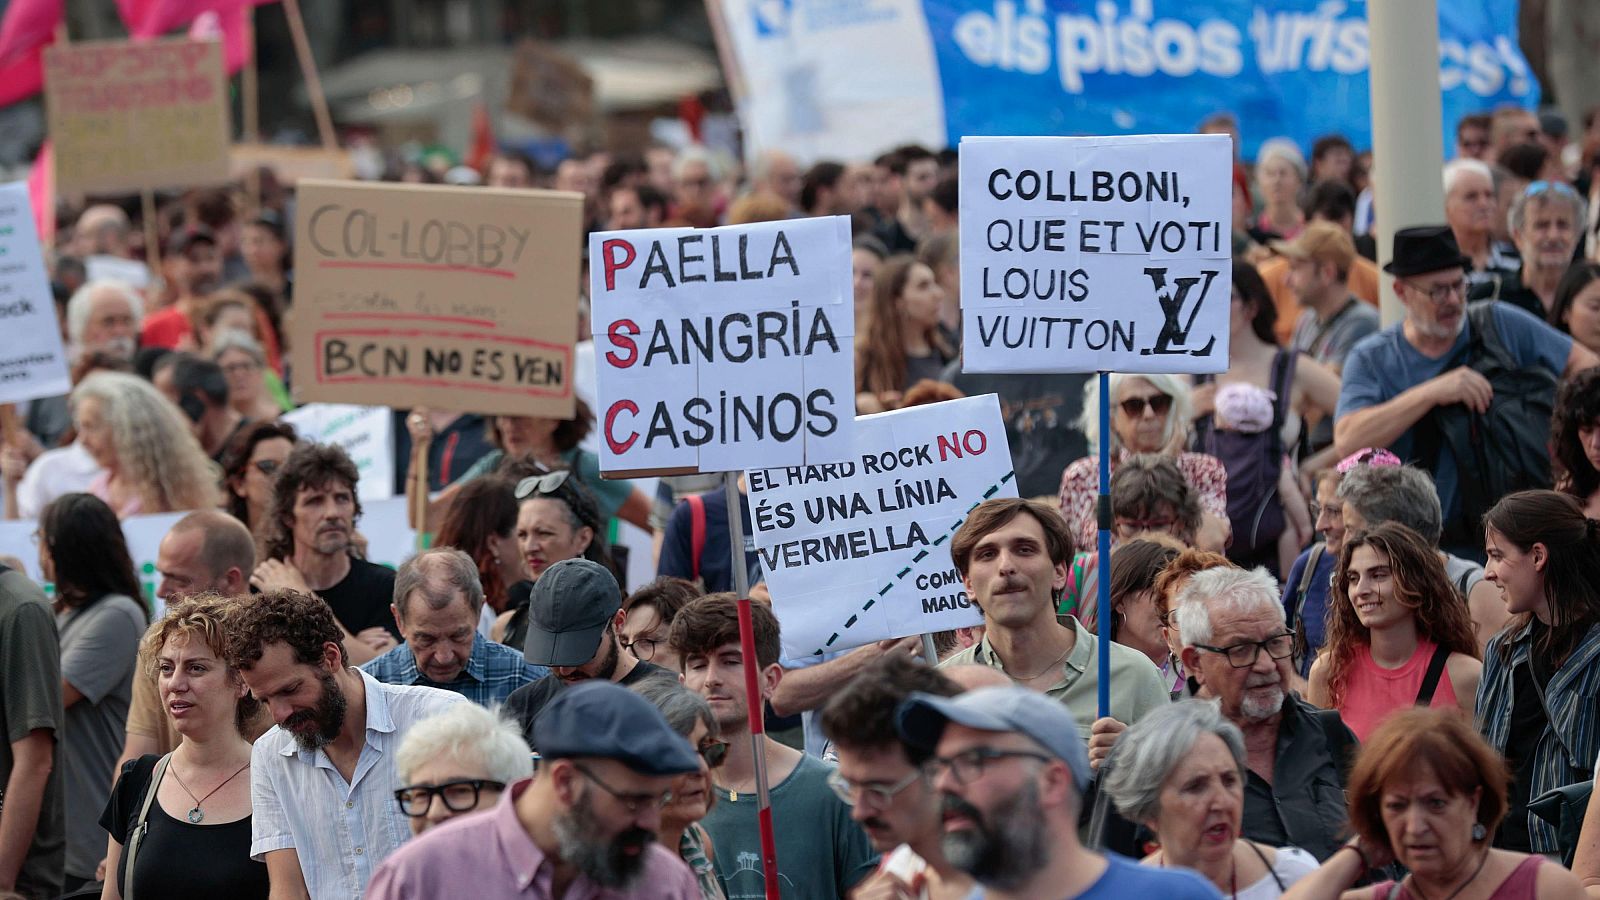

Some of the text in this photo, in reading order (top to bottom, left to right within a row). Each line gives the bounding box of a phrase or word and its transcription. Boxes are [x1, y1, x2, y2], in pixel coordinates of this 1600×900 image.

[951, 0, 1051, 75] els
[1055, 0, 1244, 94] pisos
[988, 168, 1191, 208] COLLBONI,
[987, 219, 1220, 253] QUE ET VOTI
[602, 230, 800, 292] PAELLA
[983, 267, 1090, 302] LOUIS
[977, 315, 1136, 352] VUITTON
[324, 339, 563, 386] BCN NO ES VEN
[749, 429, 988, 492] EL HARD ROCK NO
[755, 477, 958, 532] ÉS UNA LÍNIA
[759, 521, 931, 572] VERMELLA
